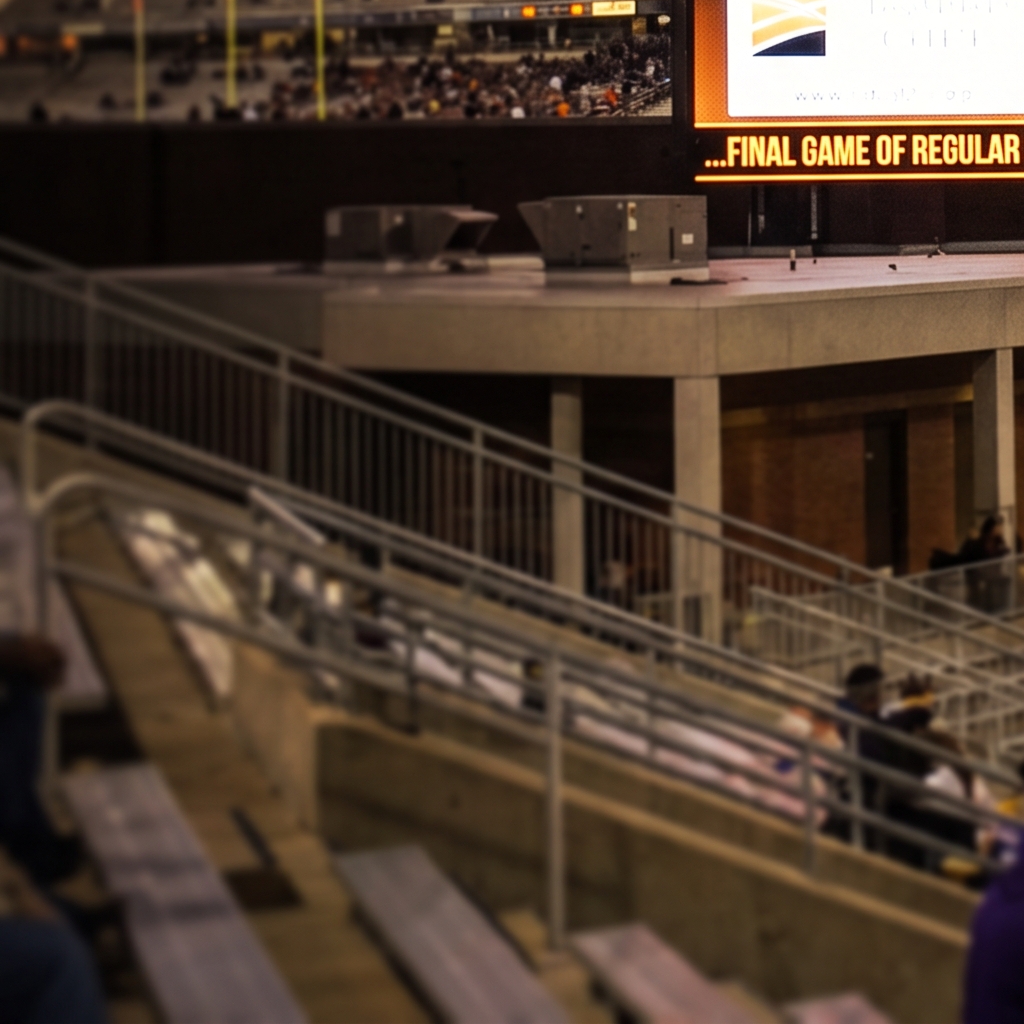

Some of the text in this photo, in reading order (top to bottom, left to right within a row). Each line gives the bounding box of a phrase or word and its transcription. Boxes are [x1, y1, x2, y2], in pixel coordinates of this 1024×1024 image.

[801, 135, 870, 167] GAME
[876, 135, 907, 166] OF
[912, 133, 1021, 166] REGULAR
